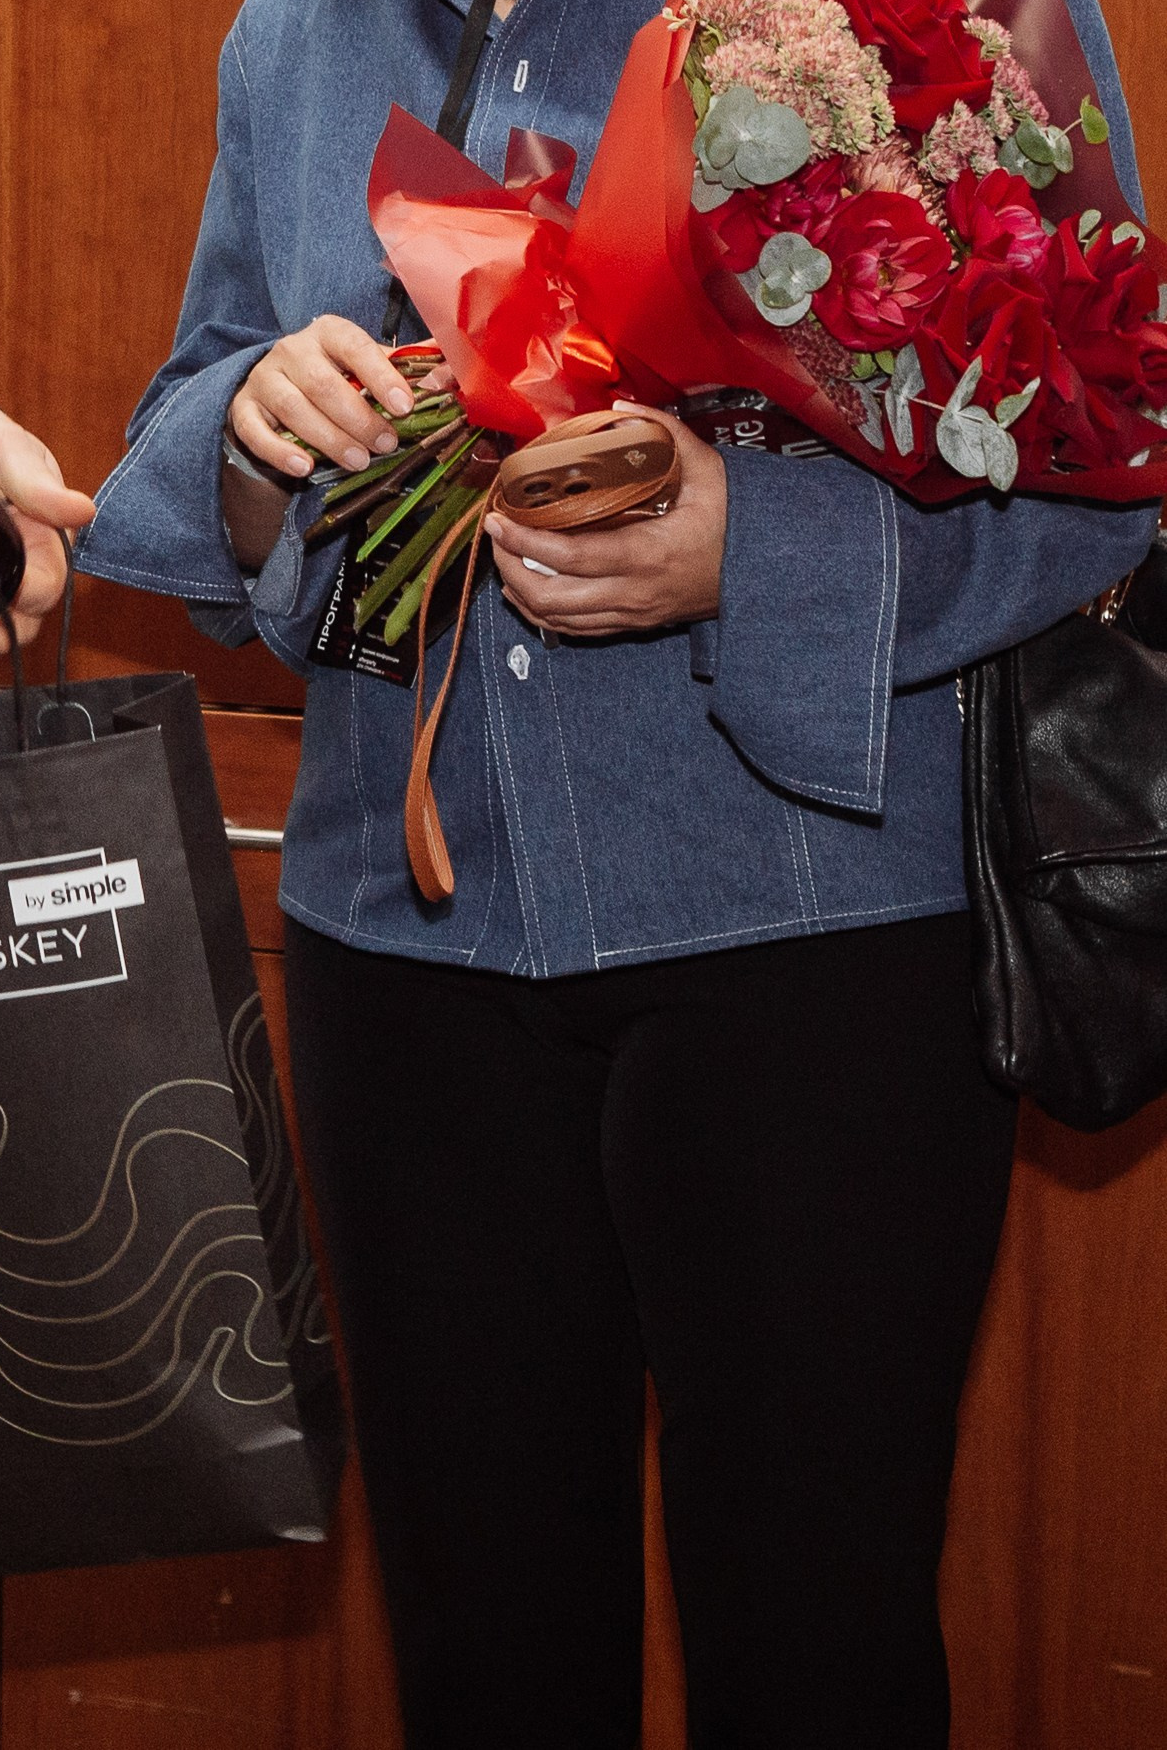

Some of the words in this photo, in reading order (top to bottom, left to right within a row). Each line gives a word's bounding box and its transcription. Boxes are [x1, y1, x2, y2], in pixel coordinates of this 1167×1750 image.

[316, 556, 346, 651] ПРОГРАМ
[25, 893, 45, 911] by
[50, 874, 128, 906] simple
